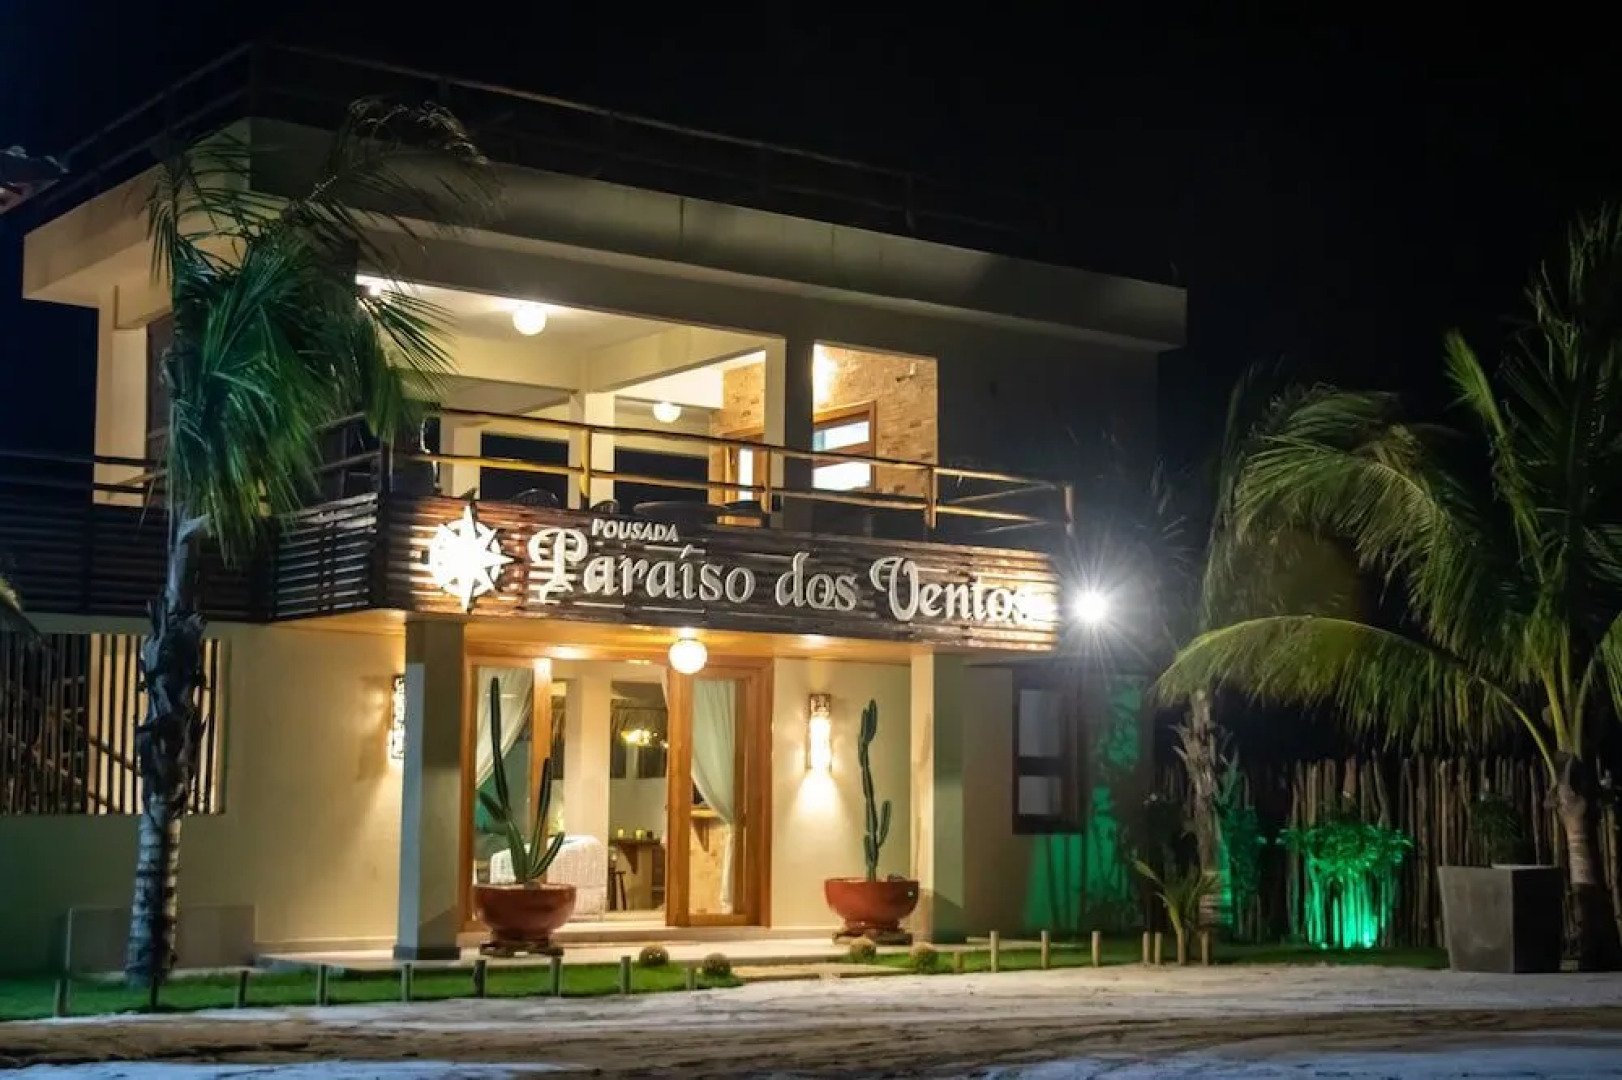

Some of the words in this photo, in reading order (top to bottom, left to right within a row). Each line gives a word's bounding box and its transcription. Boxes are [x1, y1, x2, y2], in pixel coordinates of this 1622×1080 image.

[592, 518, 679, 543] POUSADA
[528, 527, 756, 604] Paraíso
[774, 551, 858, 611] dos
